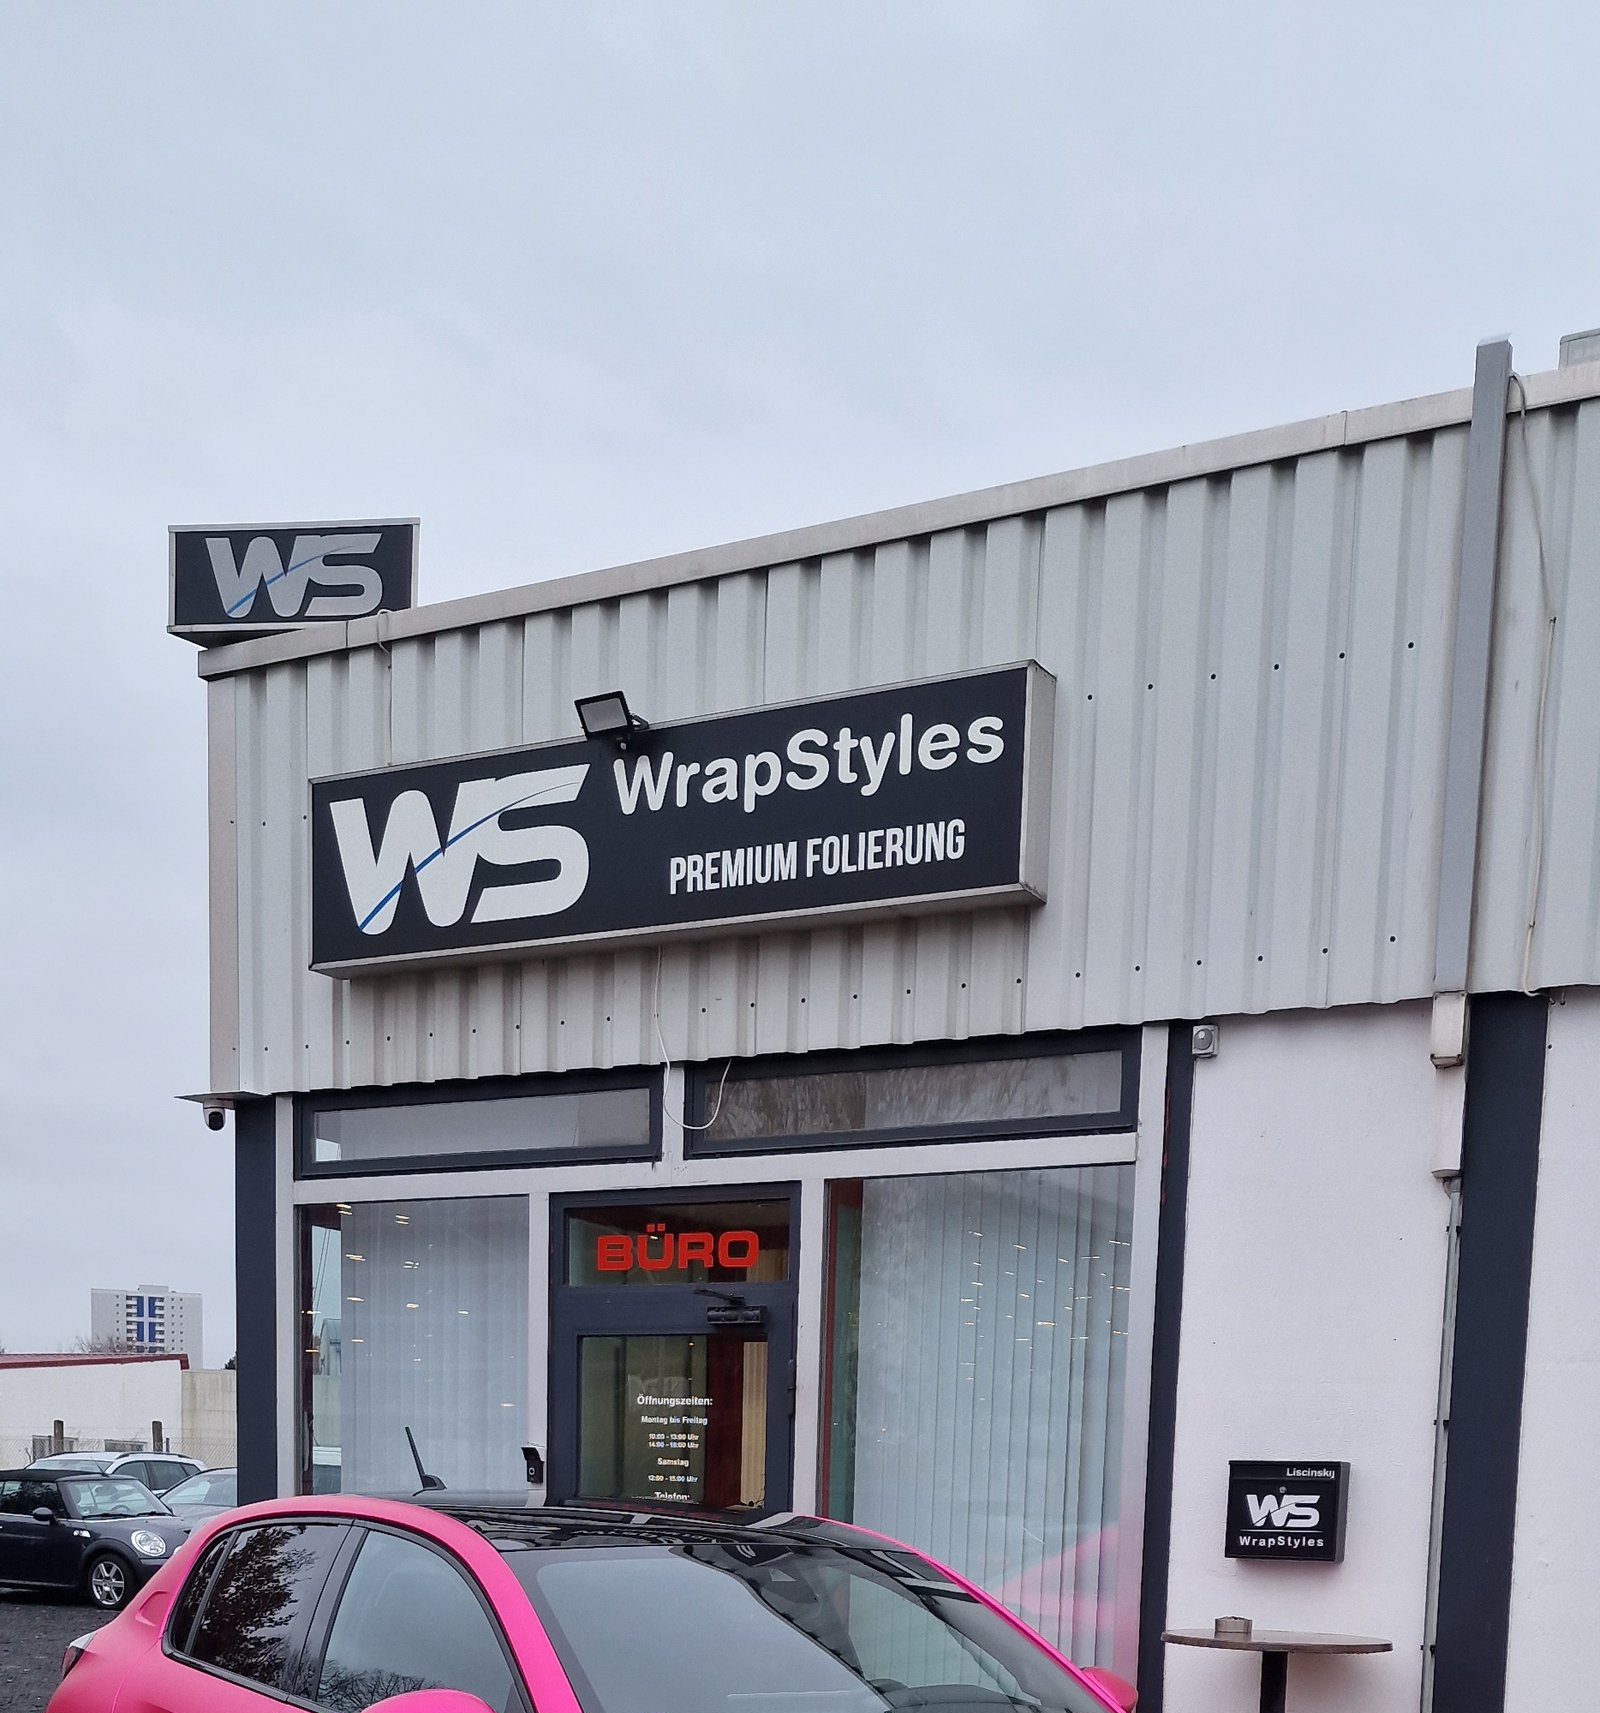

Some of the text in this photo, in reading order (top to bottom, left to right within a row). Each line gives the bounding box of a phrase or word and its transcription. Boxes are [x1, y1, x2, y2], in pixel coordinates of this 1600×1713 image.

[205, 532, 383, 619] WS
[613, 713, 1006, 815] WrapStyles
[329, 763, 591, 936] WS
[669, 818, 966, 895] PREMIUM FOLIERUNG
[595, 1223, 760, 1272] BÜRO
[637, 1393, 714, 1407] Öffnungszeiten:
[641, 1415, 708, 1426] Montag bis Freitag
[657, 1457, 690, 1467] Samstag
[1246, 1494, 1321, 1528] WS
[1239, 1535, 1325, 1549] WrapStyles
